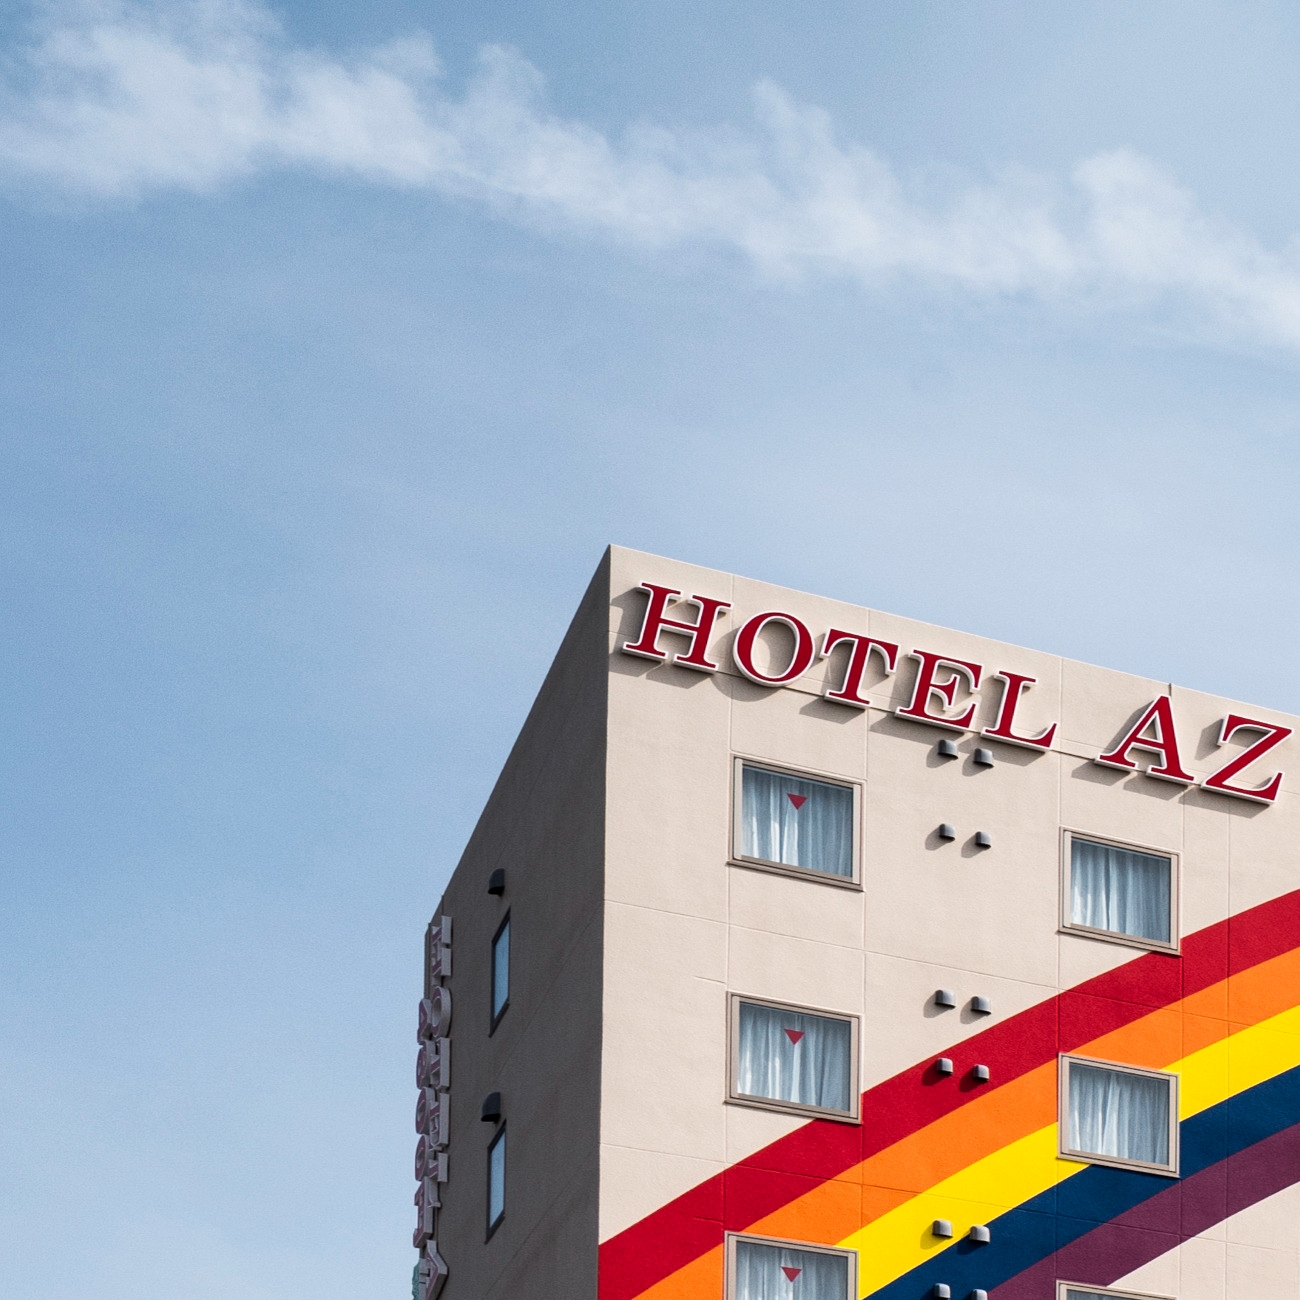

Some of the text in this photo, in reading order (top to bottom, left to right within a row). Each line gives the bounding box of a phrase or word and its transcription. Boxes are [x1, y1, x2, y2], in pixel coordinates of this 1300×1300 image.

[621, 582, 1294, 805] HOTEL AZ
[429, 915, 453, 1208] HOTEL
